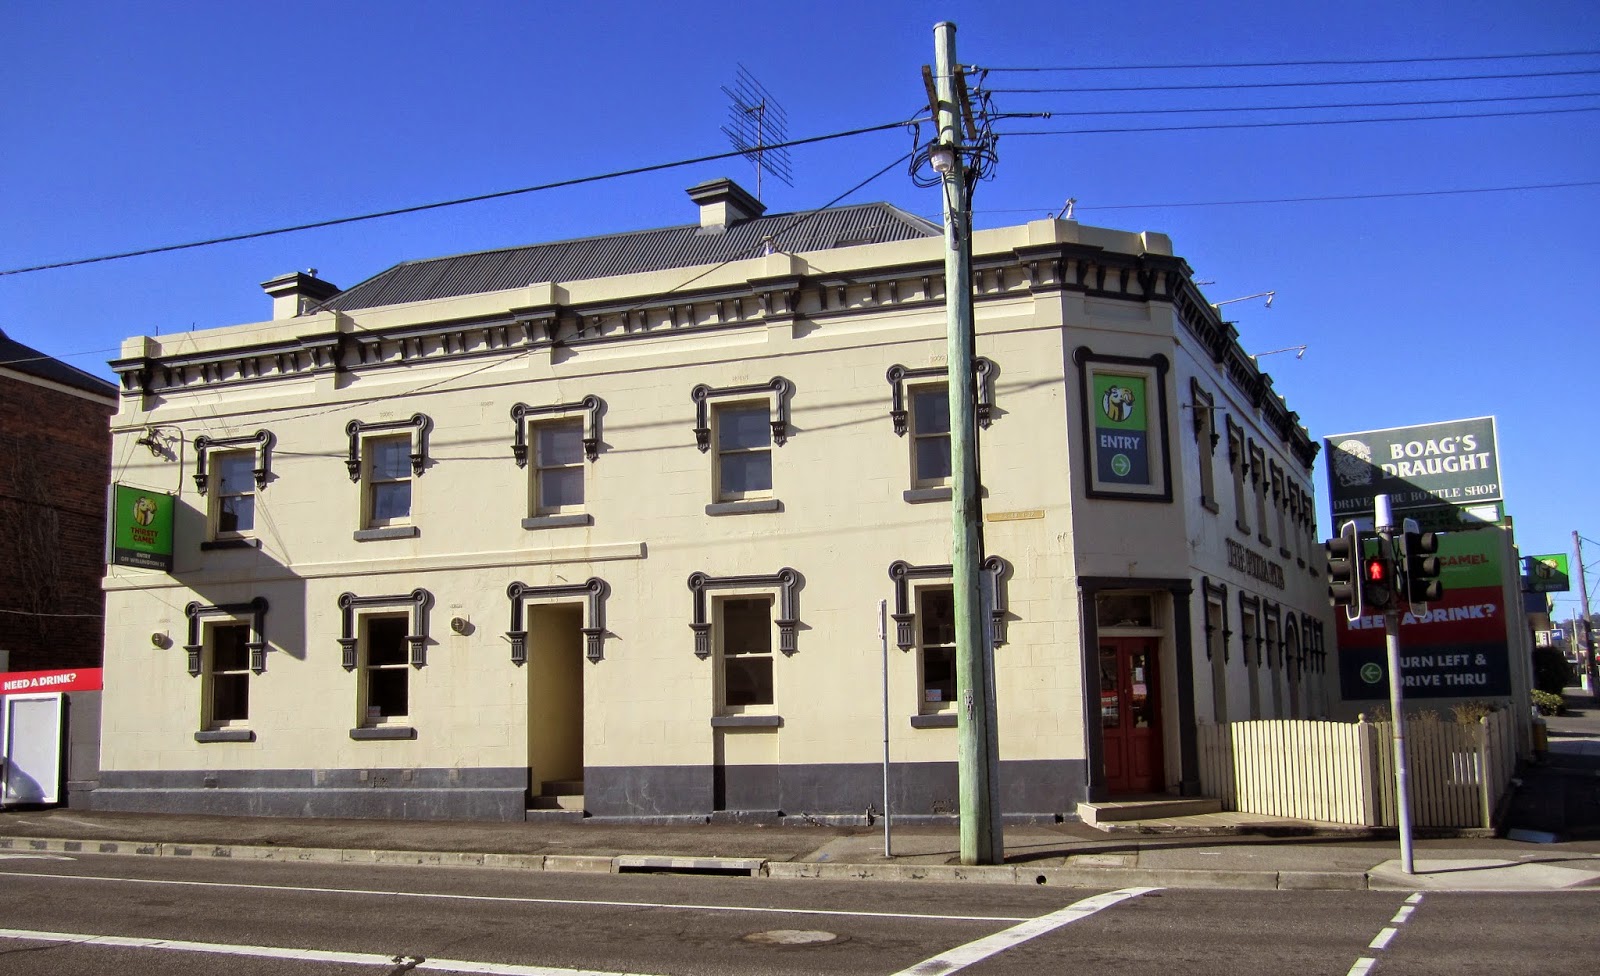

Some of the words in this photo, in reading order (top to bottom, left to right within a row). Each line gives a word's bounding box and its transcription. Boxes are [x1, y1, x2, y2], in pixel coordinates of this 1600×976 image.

[1101, 434, 1140, 449] ENTRY
[1390, 435, 1477, 459] BOAG'S
[1381, 452, 1490, 480] DRAUGHT
[1334, 492, 1406, 510] DRIVE-RU
[1411, 487, 1461, 501] BOTTLE
[1465, 483, 1497, 496] SHOP
[131, 527, 159, 537] THIRSTY
[133, 535, 155, 544] CAMEL
[1440, 553, 1489, 567] CAMEL
[1348, 614, 1386, 630] NEE
[1400, 611, 1417, 625] A
[1423, 603, 1496, 624] DRINK?
[1400, 656, 1434, 668] URN
[1438, 654, 1470, 667] LEFT
[1474, 653, 1487, 666] &
[4, 680, 30, 691] NEED
[30, 677, 39, 688] A
[39, 672, 77, 686] DRINK?
[1444, 672, 1487, 686] THRU
